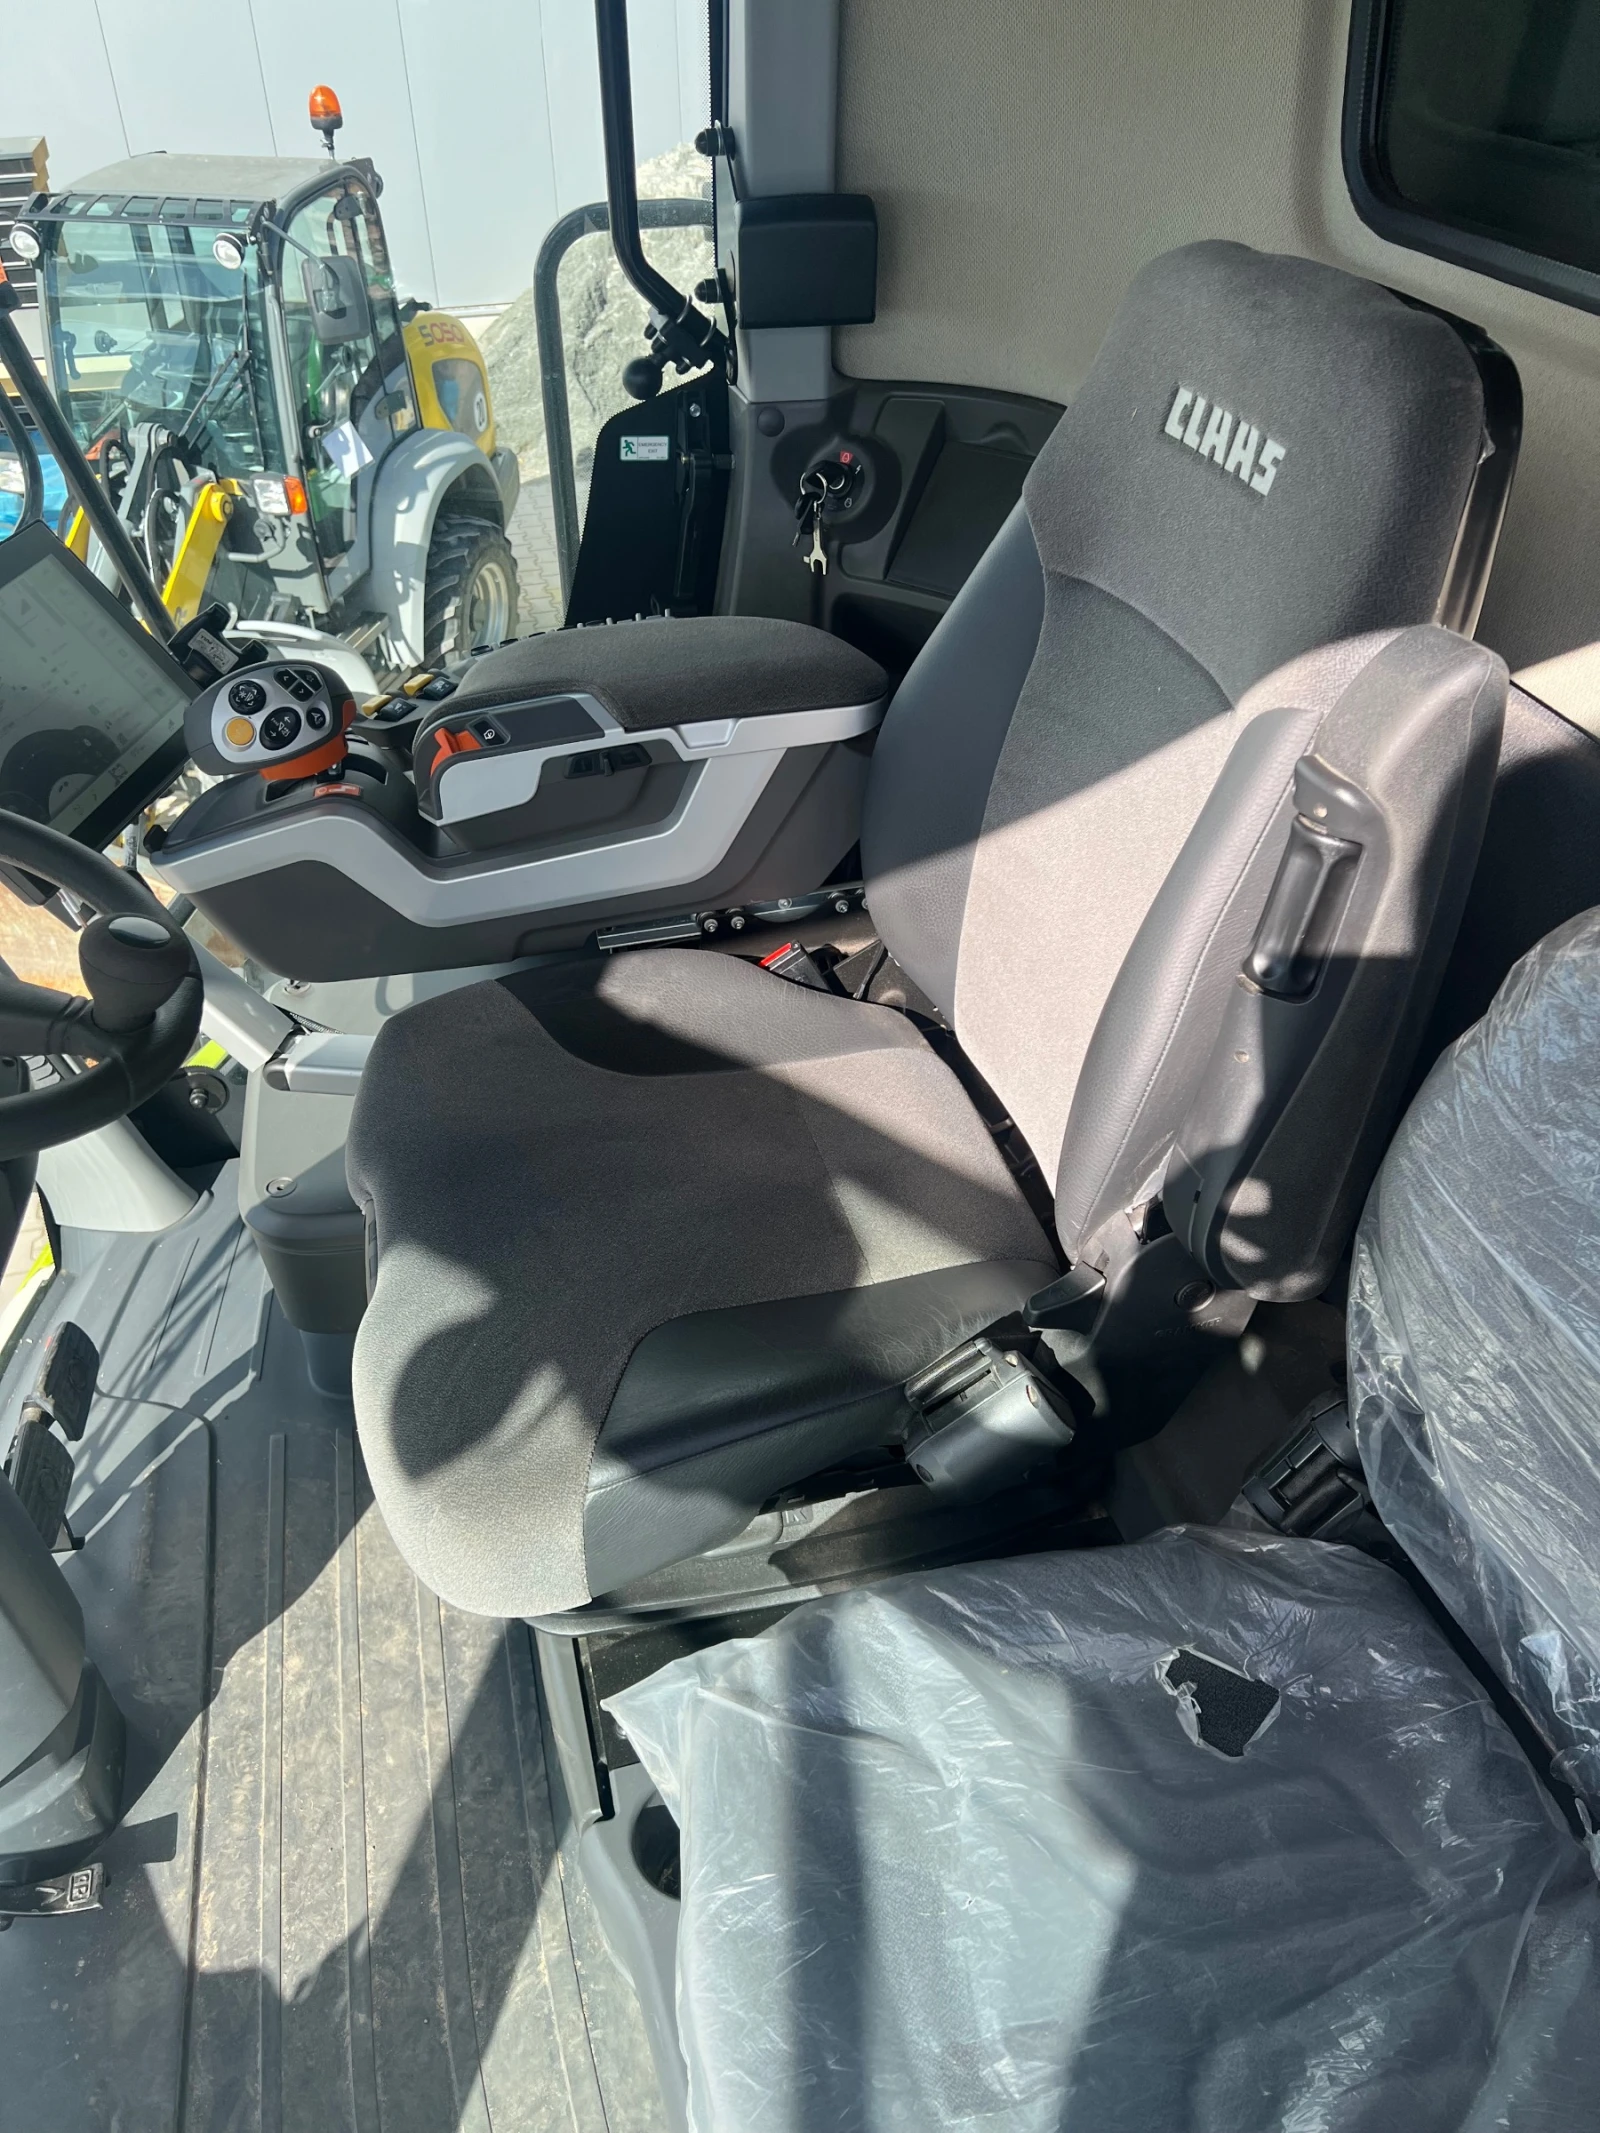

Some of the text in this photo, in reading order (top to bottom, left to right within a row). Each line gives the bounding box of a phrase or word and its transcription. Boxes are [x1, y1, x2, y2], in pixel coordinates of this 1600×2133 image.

[418, 322, 465, 347] 5050
[476, 398, 485, 427] 20
[1164, 386, 1286, 496] CLAAS
